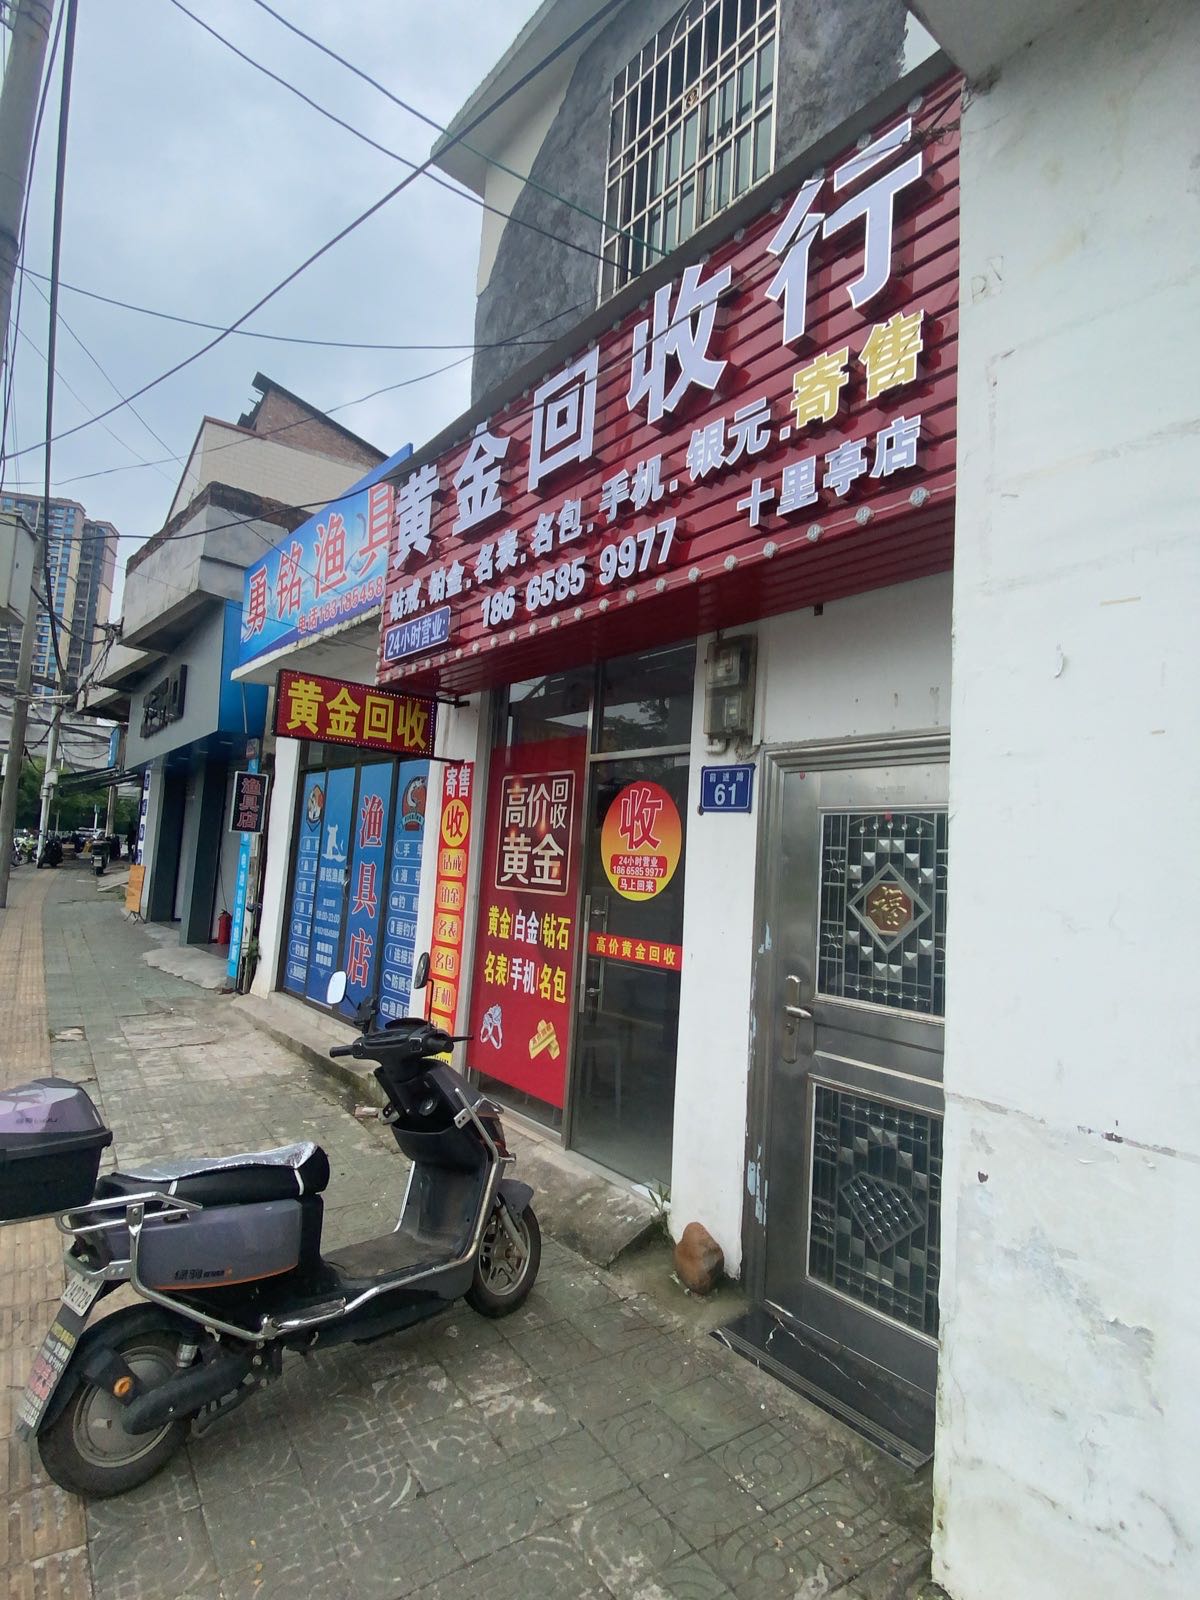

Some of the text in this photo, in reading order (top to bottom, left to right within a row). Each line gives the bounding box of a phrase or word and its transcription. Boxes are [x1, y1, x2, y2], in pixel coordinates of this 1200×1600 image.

[391, 117, 924, 571] 黄金回收行
[736, 414, 922, 527] 十里亭店
[481, 517, 677, 628] 186 6585 9977
[286, 678, 428, 750] 黄金回收
[237, 777, 262, 829] 渔具店
[445, 766, 470, 798] 寄售
[550, 779, 569, 829] 回收
[714, 783, 737, 806] 61
[446, 805, 464, 838] 收
[505, 783, 551, 829] 高价
[618, 786, 664, 852] 收
[500, 830, 565, 886] 黄金
[612, 865, 664, 879] 186 6585 9977
[618, 855, 658, 869] 24小时营业
[345, 794, 384, 989] 渔具店
[619, 877, 656, 893] 马上回来
[437, 920, 457, 938] 名表
[596, 936, 677, 966] 高价黄金回收
[435, 952, 455, 971] 名包
